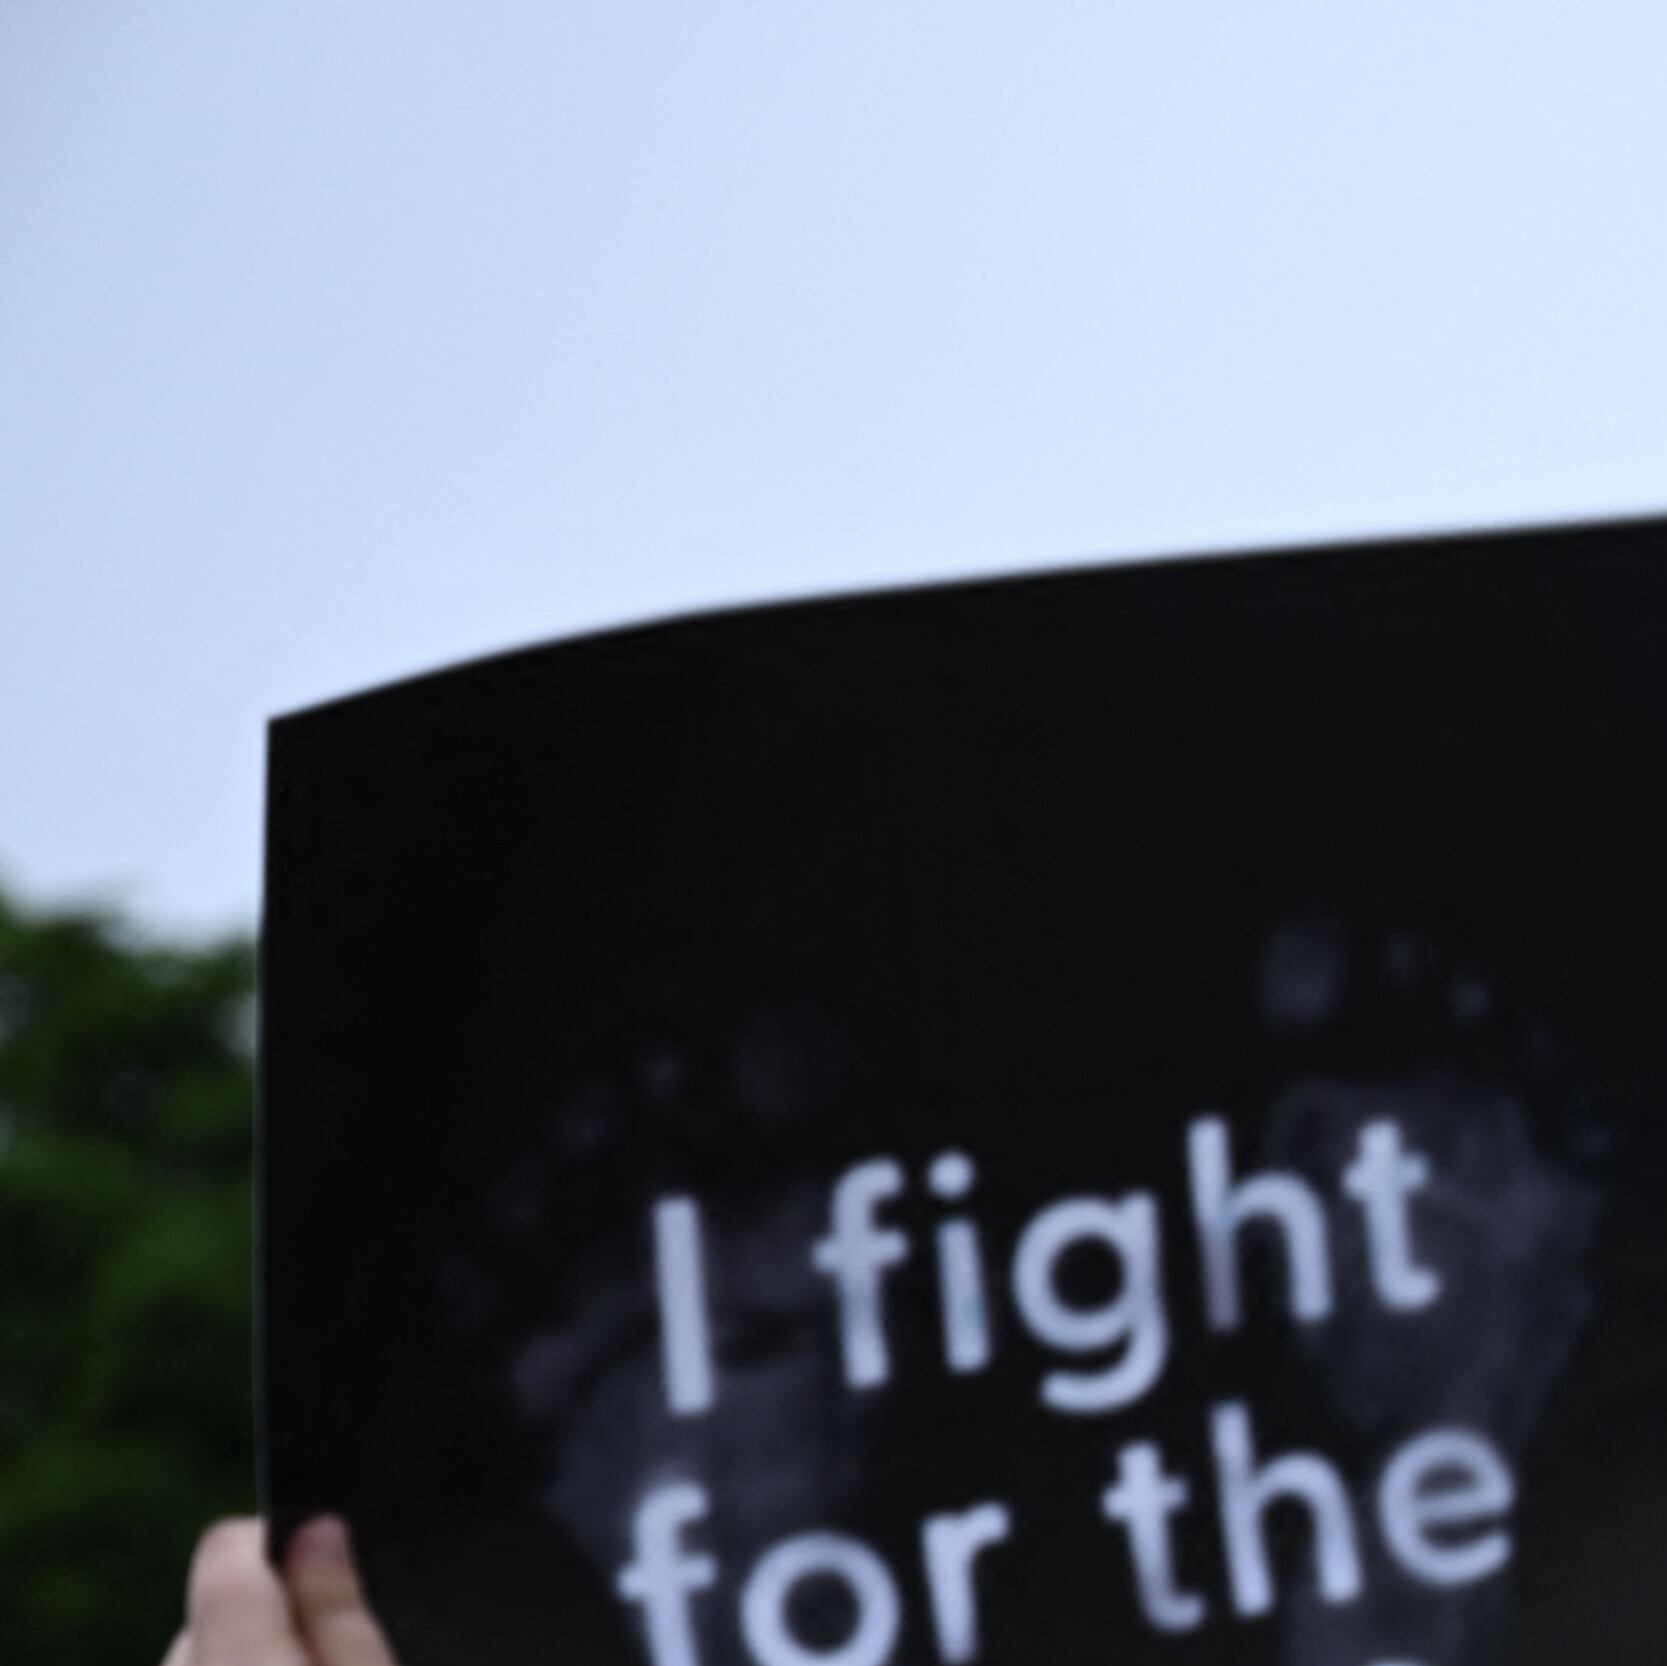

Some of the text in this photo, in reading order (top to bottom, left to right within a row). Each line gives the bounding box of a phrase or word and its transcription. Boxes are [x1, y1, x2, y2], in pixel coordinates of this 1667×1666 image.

[652, 1114, 1441, 1416] I fight
[1101, 1400, 1515, 1632] the
